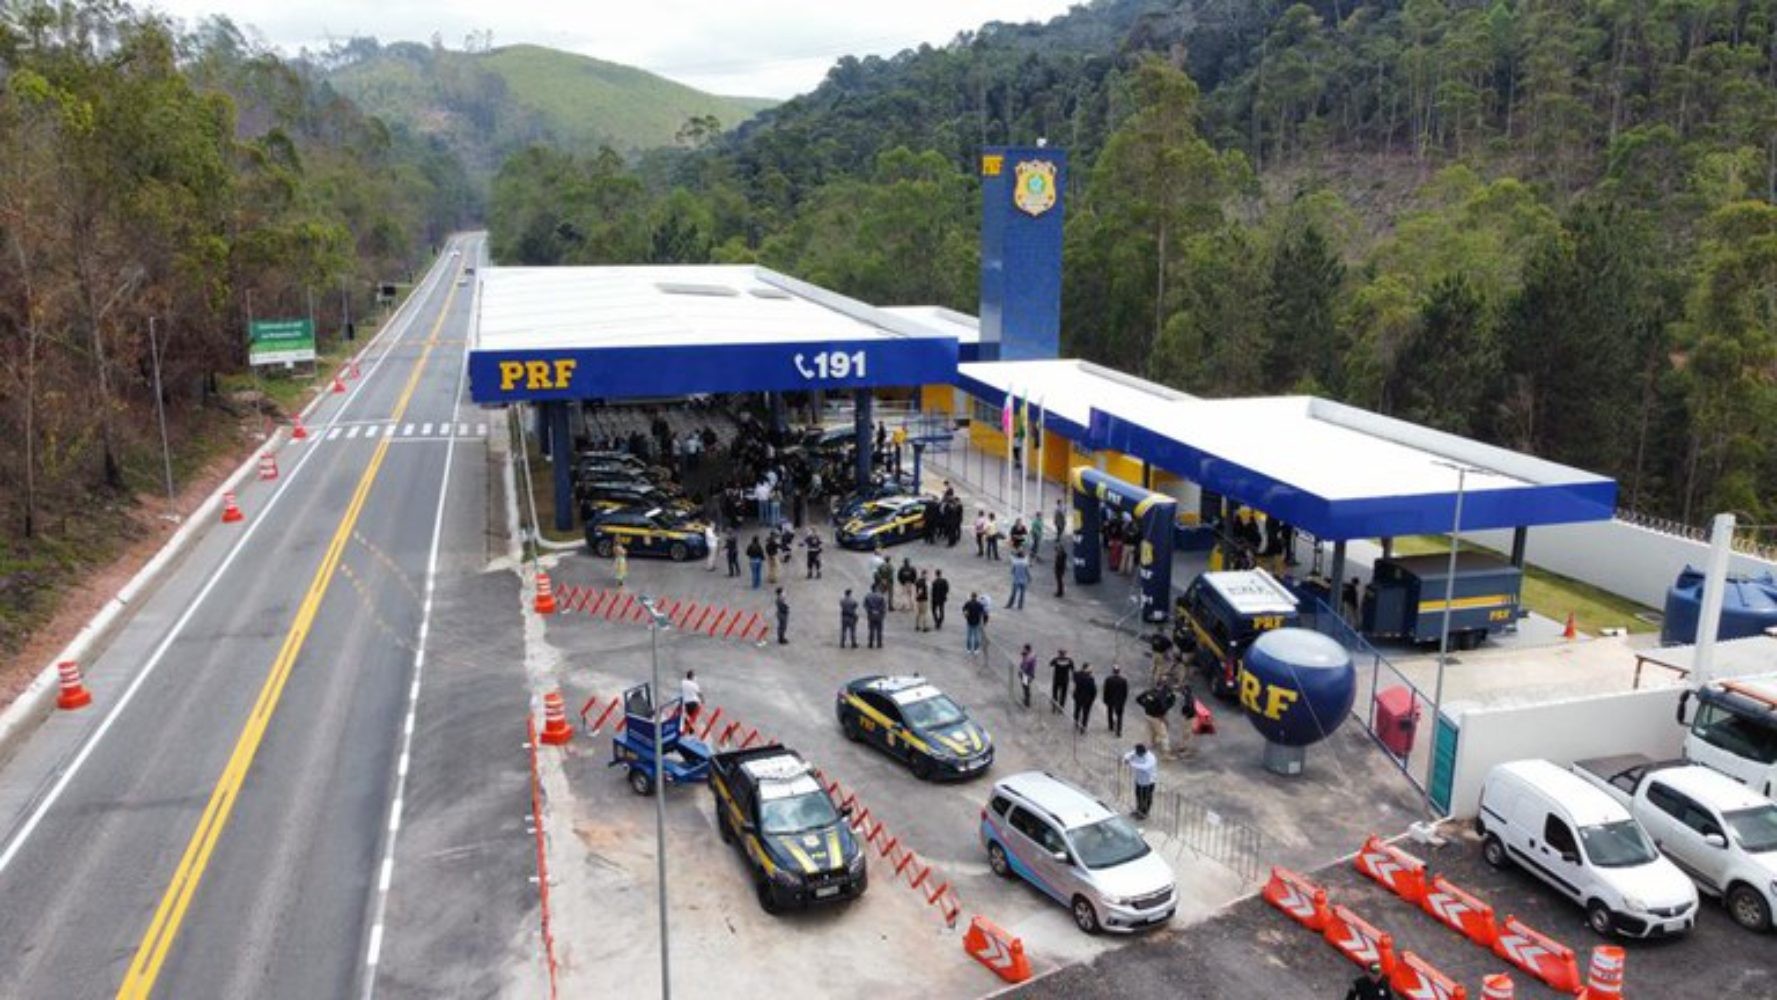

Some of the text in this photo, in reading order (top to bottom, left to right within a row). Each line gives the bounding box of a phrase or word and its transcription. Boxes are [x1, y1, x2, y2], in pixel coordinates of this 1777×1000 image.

[499, 359, 577, 391] PRF
[814, 350, 867, 379] 191
[1253, 615, 1285, 630] PRF
